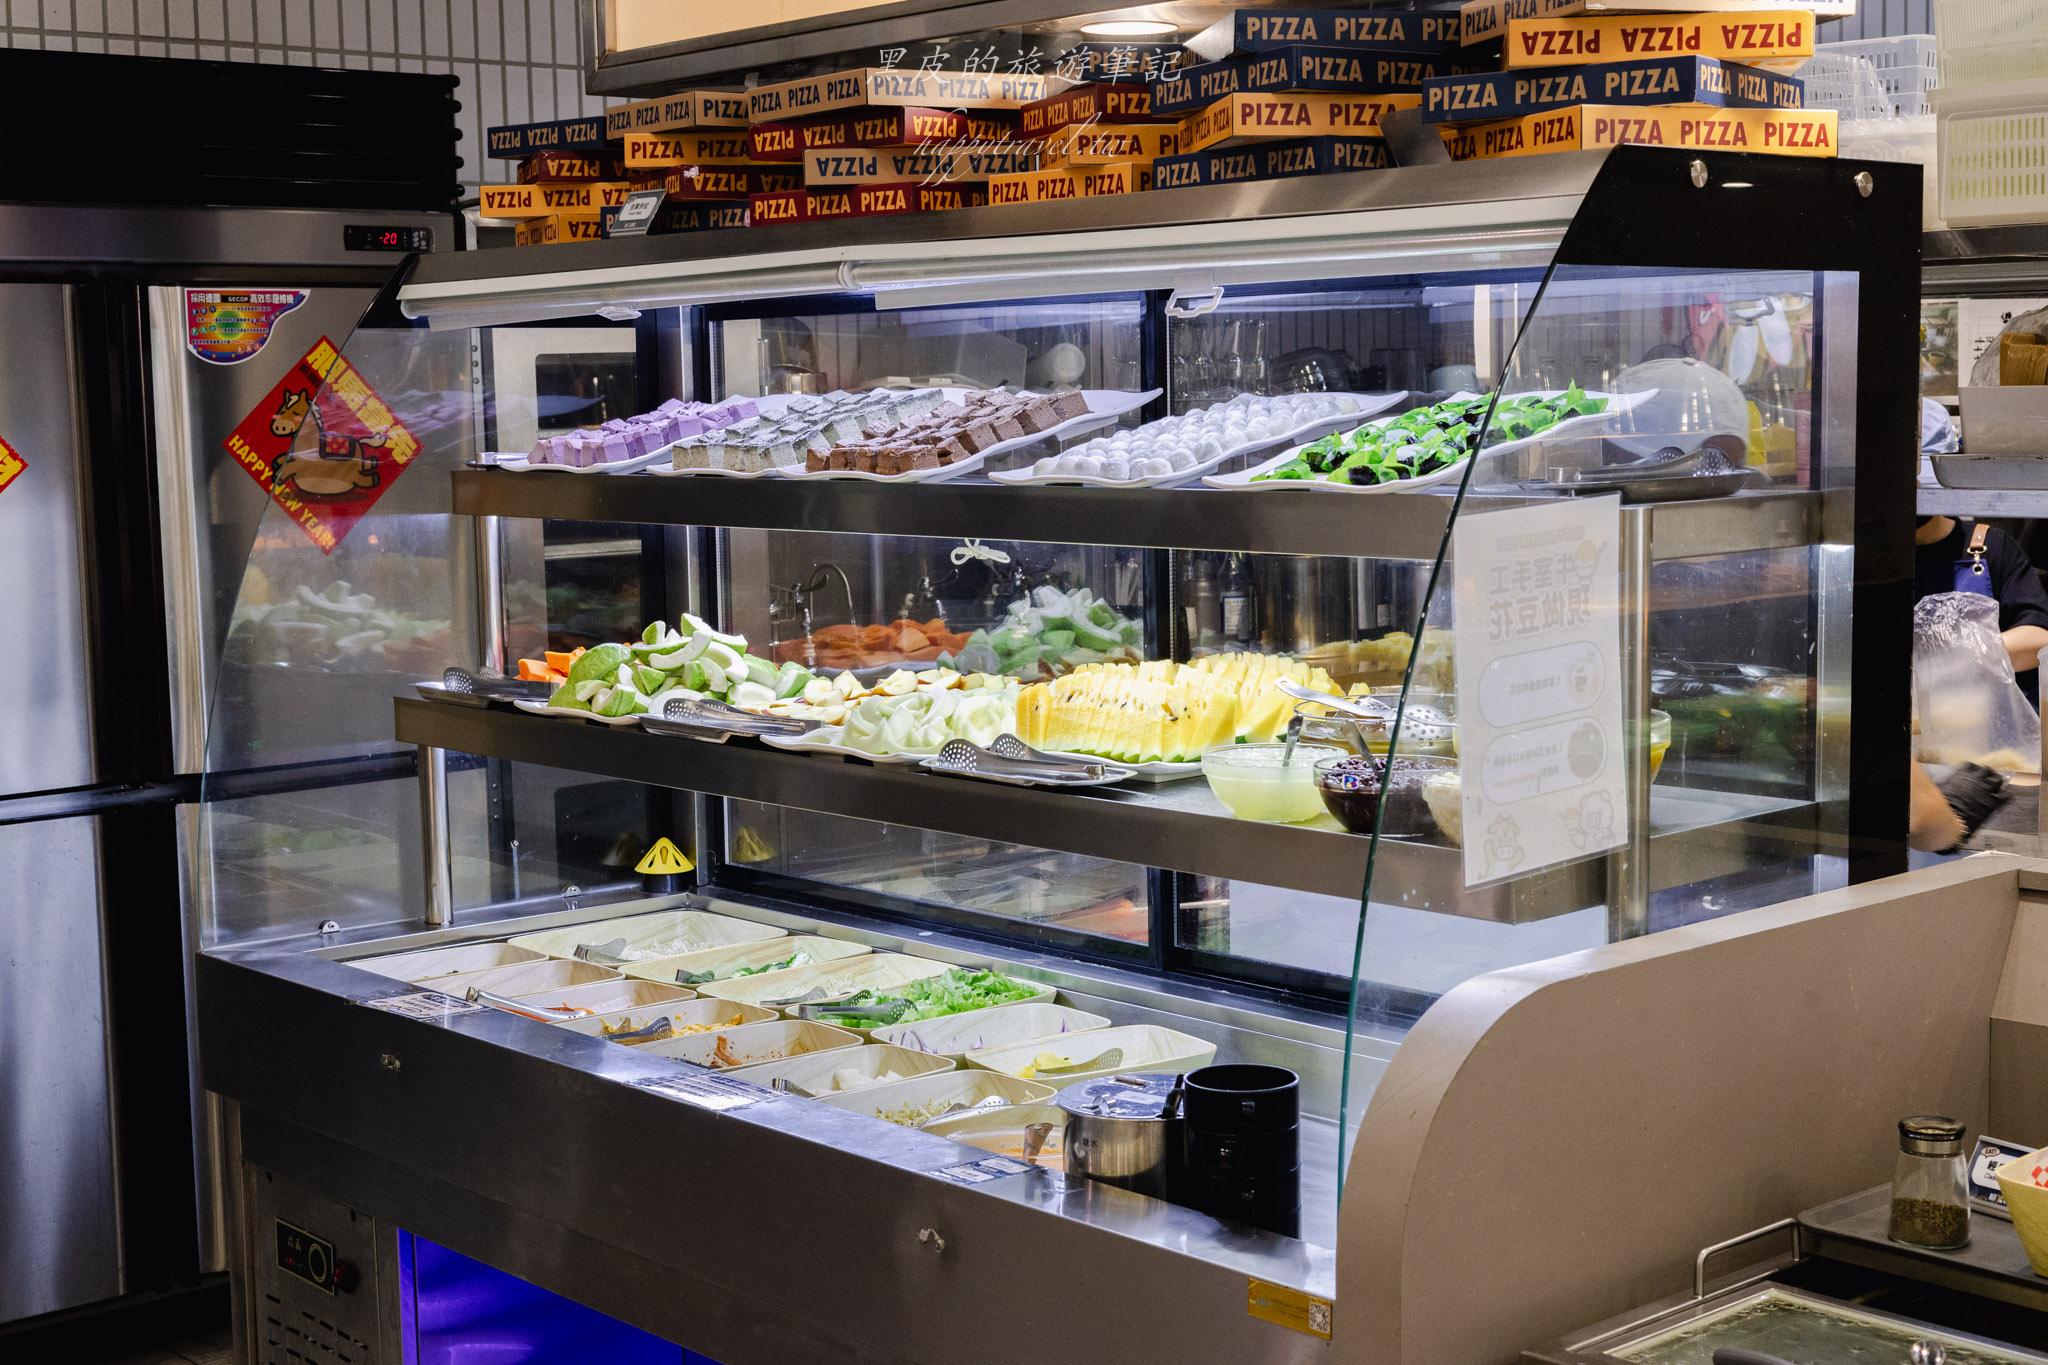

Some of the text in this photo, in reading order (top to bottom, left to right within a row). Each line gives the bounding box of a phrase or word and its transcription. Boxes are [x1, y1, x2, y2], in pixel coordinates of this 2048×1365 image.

[1246, 17, 1459, 40] PIZZA PIZZA PIZ
[1464, 5, 1497, 37] PIZZA
[1521, 23, 1801, 56] PIZZA PIZZA PIZZA
[1156, 58, 1288, 106] PIZZA PIZZA PIZZA
[1302, 56, 1363, 82] PIZZA
[751, 78, 861, 114] PIZZA PIZZA PIZZA
[872, 75, 927, 97] PIZZA
[938, 79, 990, 100] PIZZA
[1429, 67, 1680, 111] PIZZA PIZZA PIZZA
[1700, 64, 1801, 109] PIZZA PIZZA PIZZA
[607, 101, 690, 131] PIZZA PIZZA PIZZA
[1023, 95, 1096, 132] PIZZA PIZZA PIZZA
[1107, 93, 1151, 114] PIZZ
[1240, 103, 1311, 125] PIZZA
[491, 123, 597, 149] PIZZA PIZZA PIZZA
[754, 117, 898, 152] PIZZA PIZZA PIZZA
[912, 115, 1010, 140] PIZZA PIZZA
[1195, 115, 1211, 142] PIZZA
[1213, 105, 1230, 134] PIZZA
[1485, 125, 1524, 155] PIZZA
[1533, 115, 1575, 146] PIZZA
[1595, 118, 1830, 148] PIZZA PIZZA PIZZA
[631, 140, 750, 159] PIZZA PIZZA
[1077, 135, 1143, 155] PIZZA
[1334, 143, 1386, 168] PIZZA
[547, 159, 600, 177] PIZZA
[816, 153, 1029, 176] PIZZA PIZZA PIZZA
[1156, 161, 1200, 188] PIZZA
[1210, 154, 1257, 182] PIZZA
[1267, 146, 1316, 174] PIZZA
[693, 173, 747, 191] PIZZA
[992, 182, 1029, 203] PIZZA
[1037, 178, 1076, 200] PIZZA
[1084, 173, 1125, 196] PIZZA
[485, 191, 532, 208] PIZZA
[543, 190, 590, 207] PIZZA
[755, 189, 907, 220] PIZZA PIZZA PIZZA
[920, 190, 963, 210] PIZZA
[709, 208, 750, 228] PIZZA
[379, 232, 398, 245] -20
[228, 434, 273, 480] HAPPY
[269, 481, 303, 512] NEW
